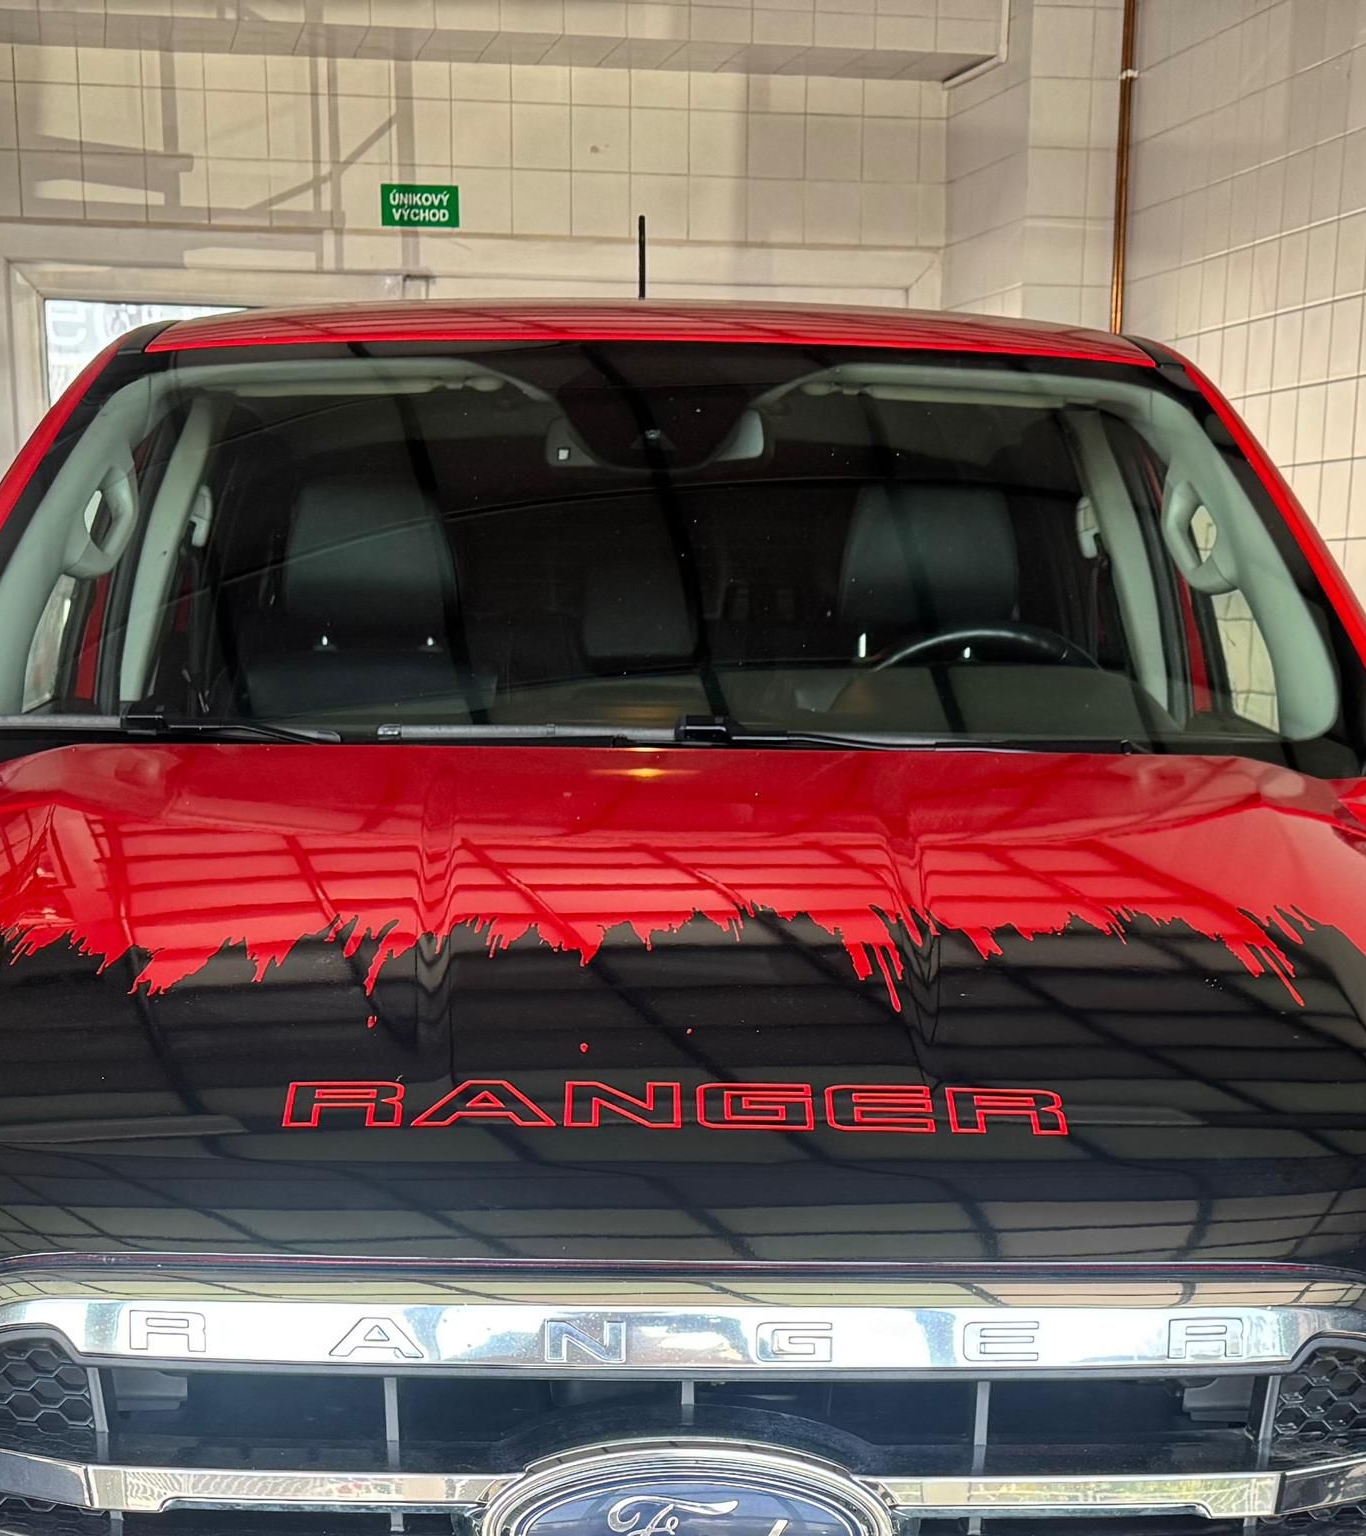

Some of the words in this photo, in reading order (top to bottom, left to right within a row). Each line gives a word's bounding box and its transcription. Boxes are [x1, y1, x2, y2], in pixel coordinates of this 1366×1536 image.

[389, 189, 450, 206] ÚNIKOVÝ
[392, 205, 449, 222] VÝCHOD
[281, 1079, 1069, 1136] RANGER
[129, 1309, 1244, 1364] RANGER
